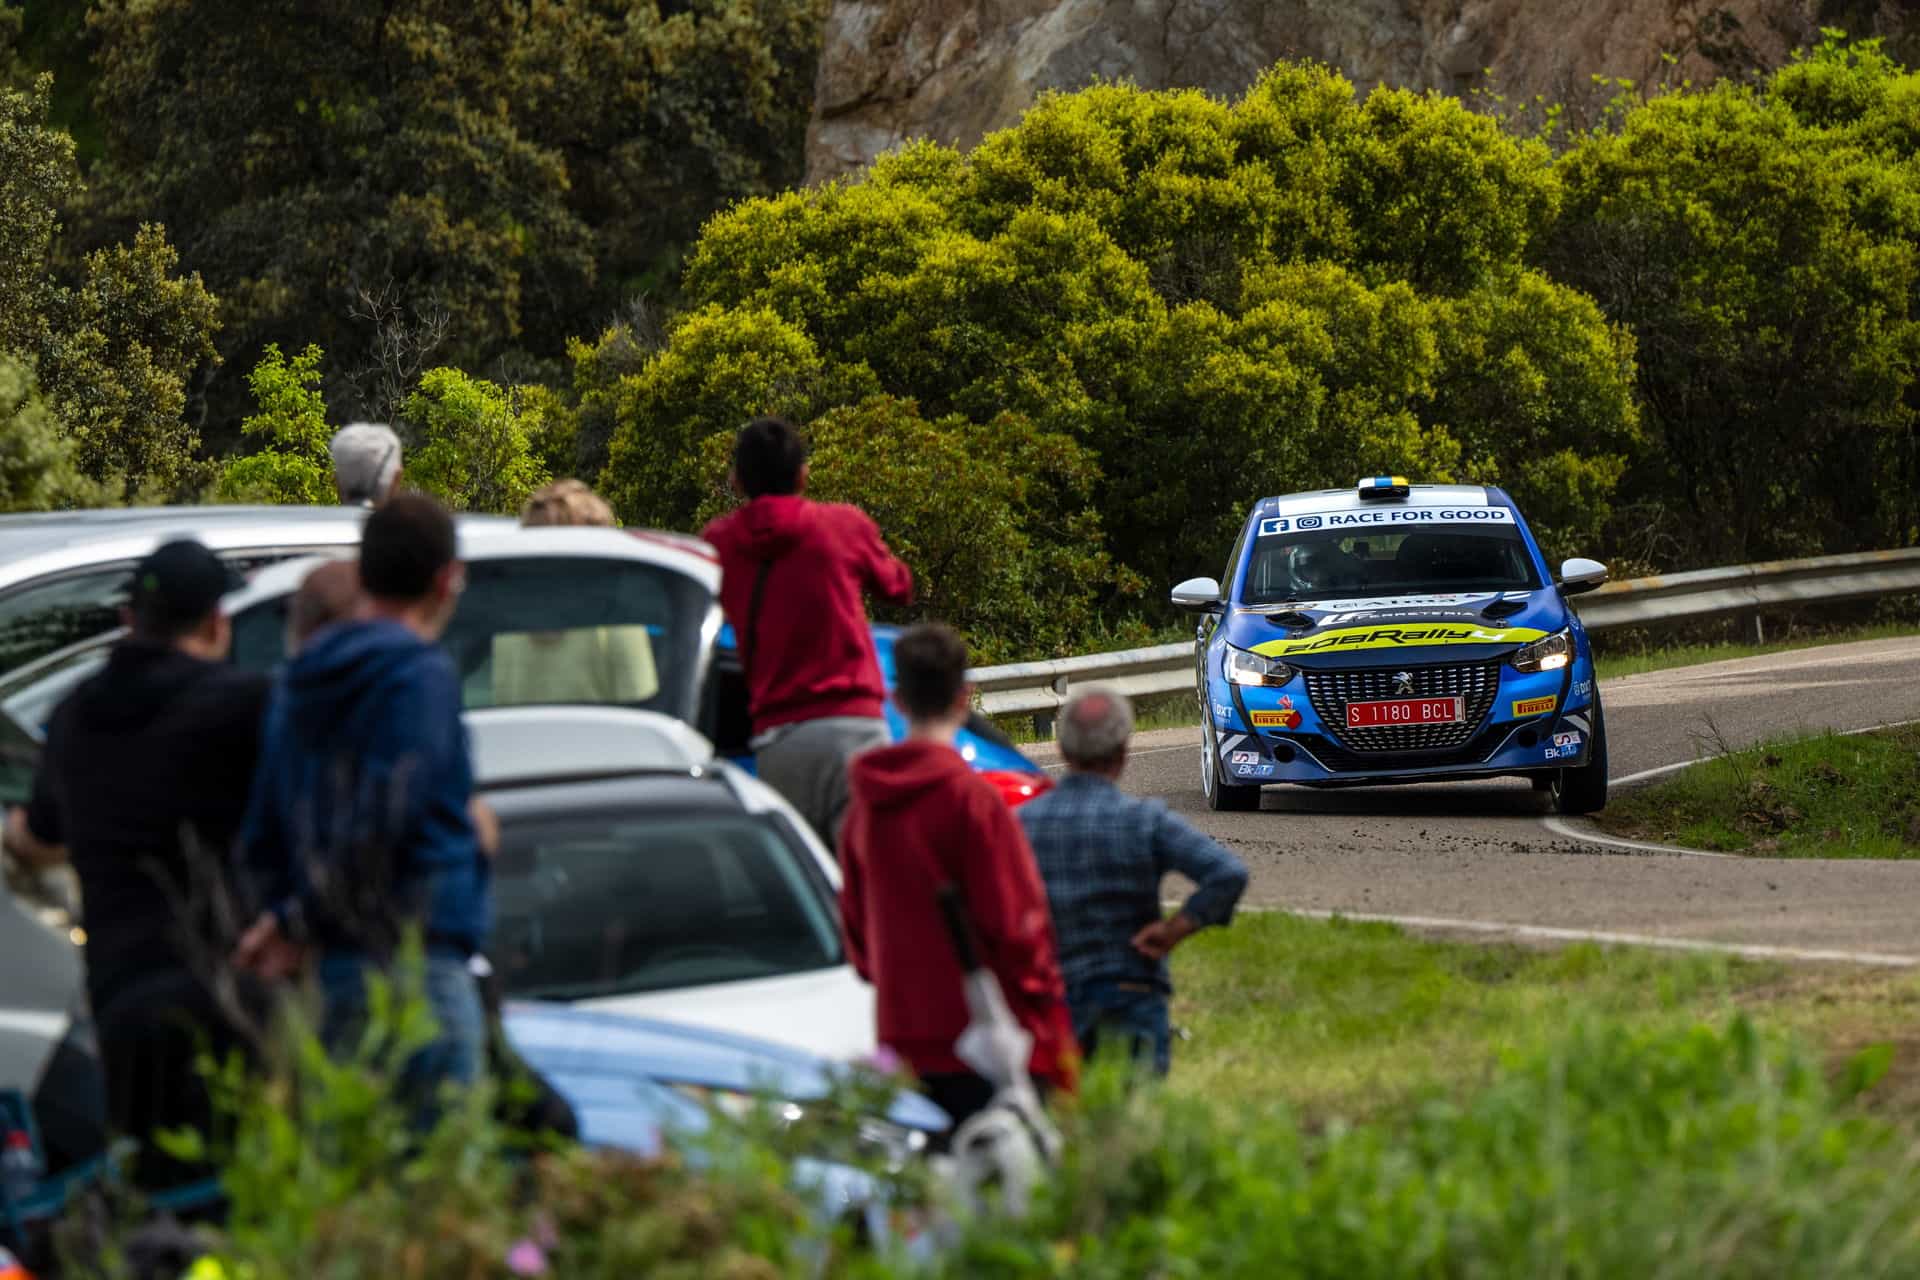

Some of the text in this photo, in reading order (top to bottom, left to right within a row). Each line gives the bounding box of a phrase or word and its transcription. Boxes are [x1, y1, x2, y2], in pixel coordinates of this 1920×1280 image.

[1329, 509, 1505, 525] RACE FOR GOOD
[1351, 702, 1452, 722] S 1180 BCL
